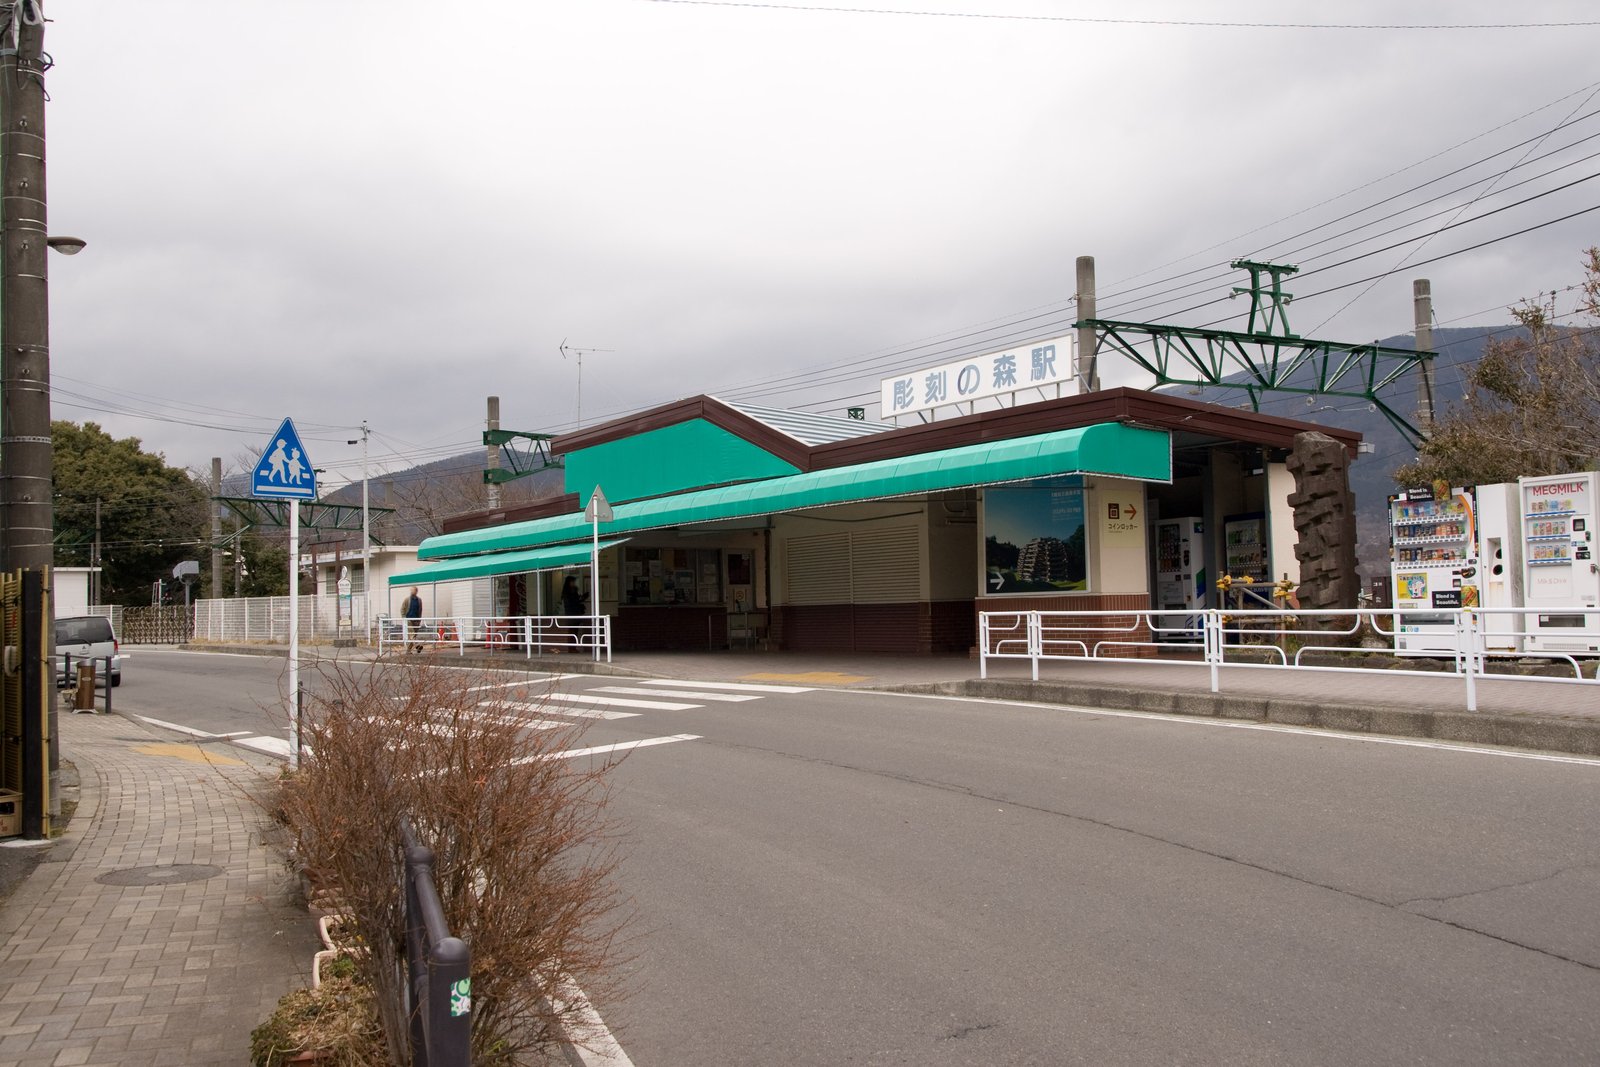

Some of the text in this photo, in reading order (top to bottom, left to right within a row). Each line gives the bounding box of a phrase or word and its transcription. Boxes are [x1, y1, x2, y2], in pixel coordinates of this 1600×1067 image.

[893, 344, 1056, 411] 彫刻の森駅
[1532, 481, 1584, 496] MEGMILK
